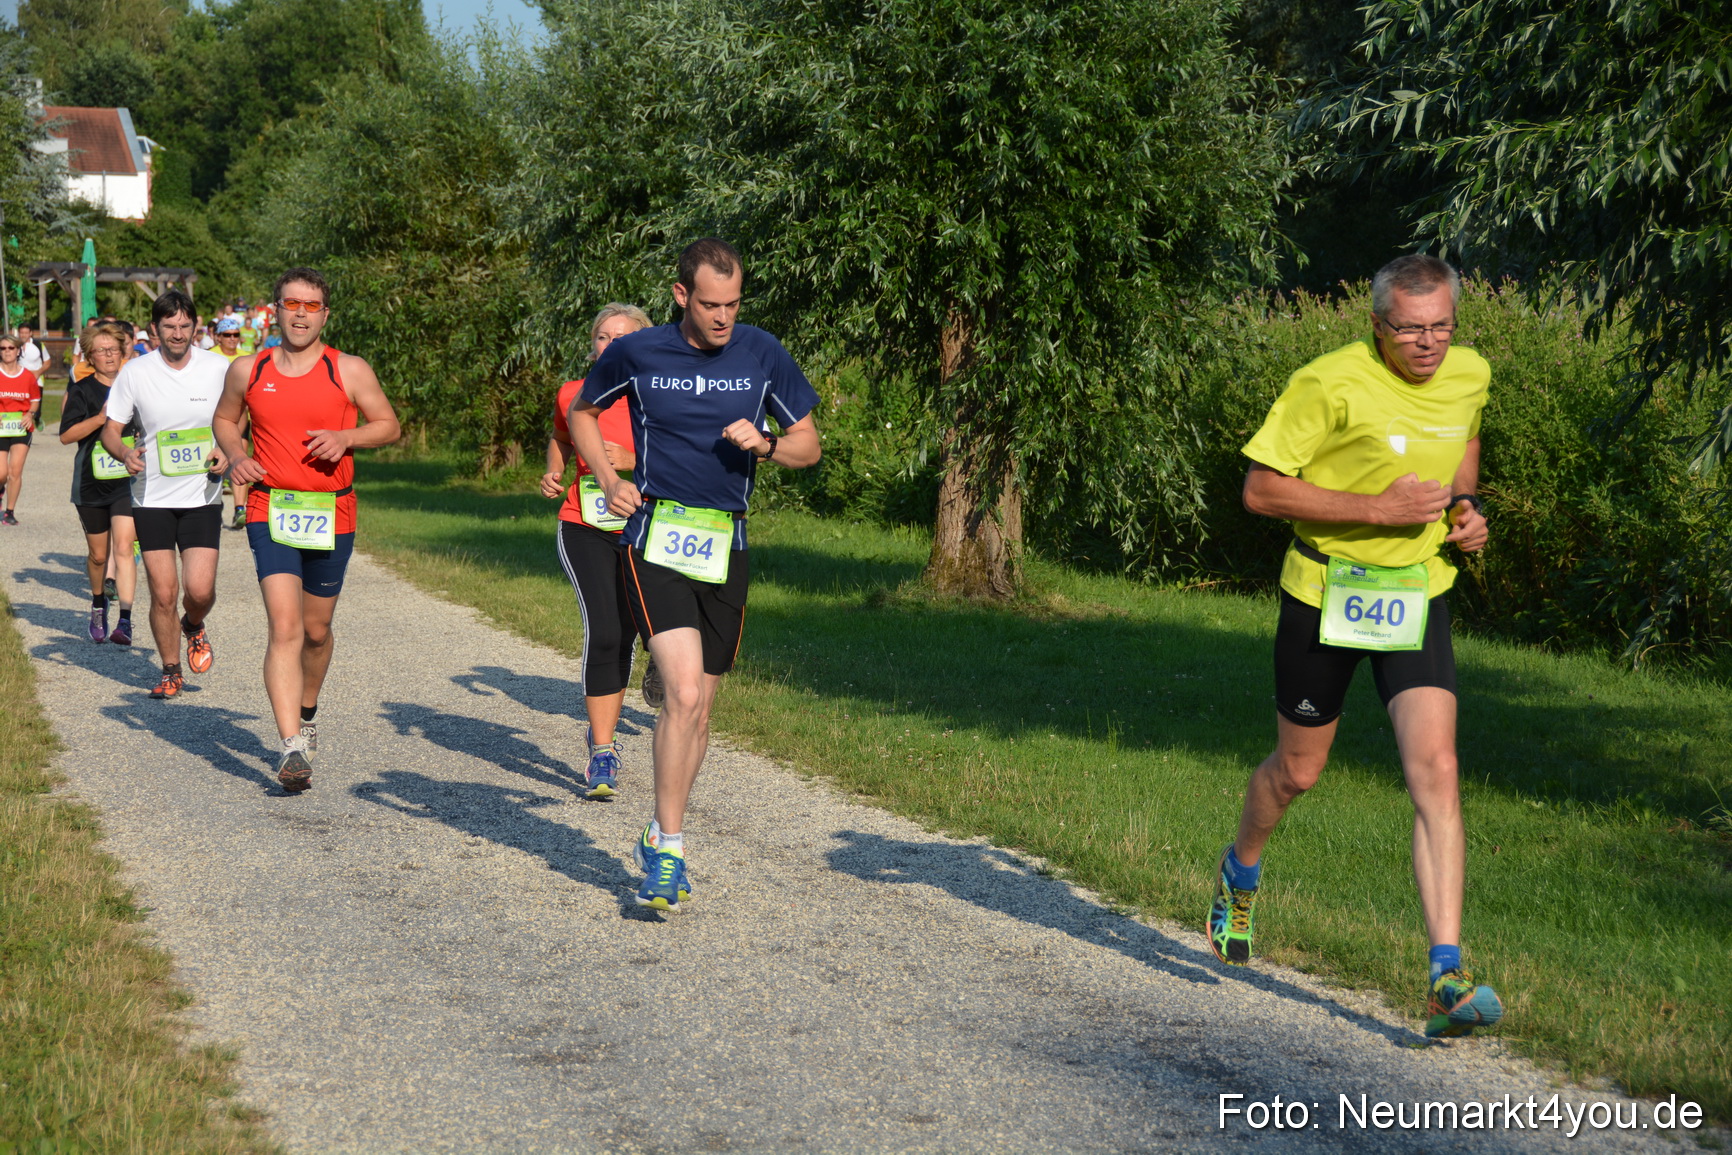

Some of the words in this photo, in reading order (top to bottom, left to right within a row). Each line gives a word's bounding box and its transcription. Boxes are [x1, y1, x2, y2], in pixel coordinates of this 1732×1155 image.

[651, 376, 693, 391] EURO
[708, 378, 752, 391] POLES
[170, 446, 201, 464] 981
[276, 513, 328, 534] 1372
[664, 530, 714, 561] 364
[1344, 595, 1406, 627] 640
[1353, 628, 1370, 637] Peter
[1370, 630, 1392, 639] Erhard
